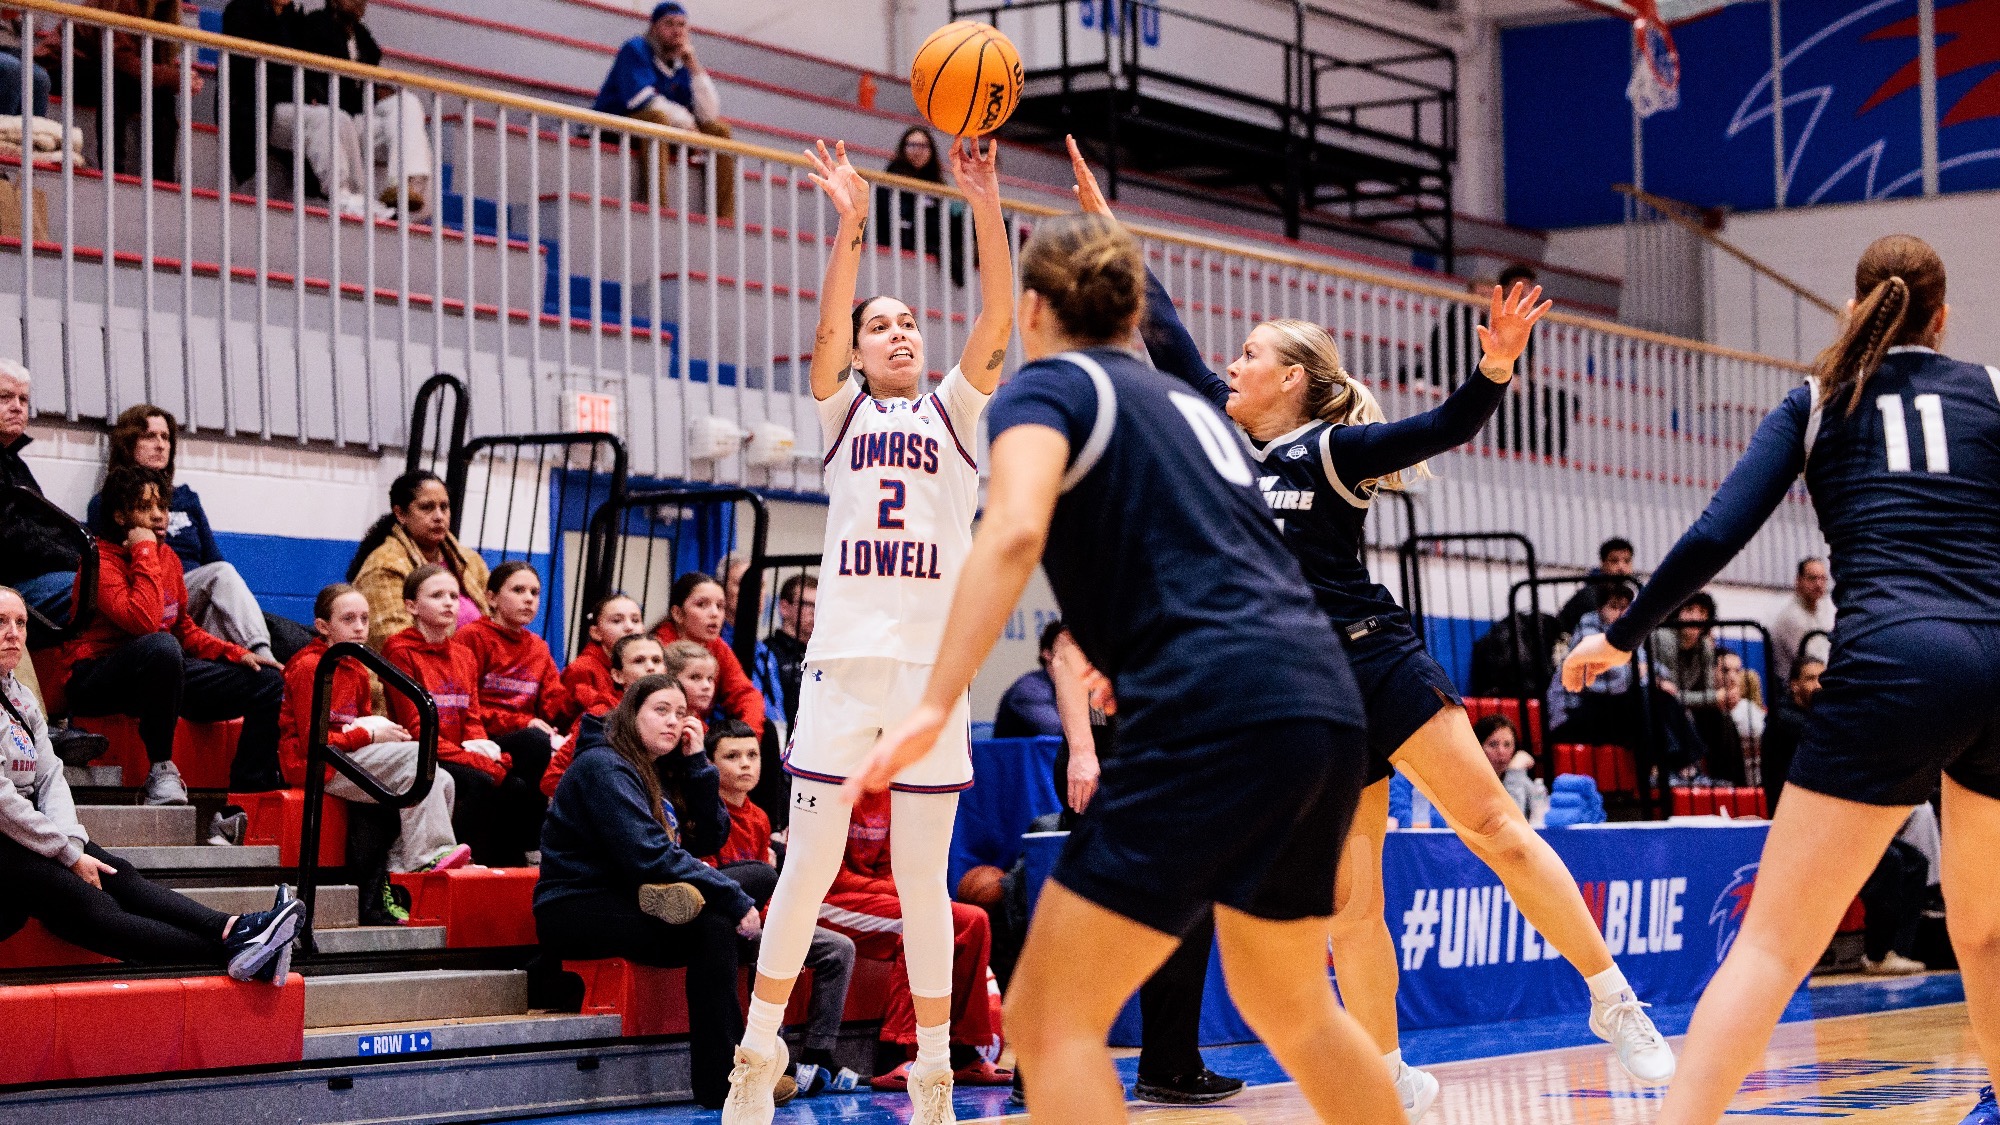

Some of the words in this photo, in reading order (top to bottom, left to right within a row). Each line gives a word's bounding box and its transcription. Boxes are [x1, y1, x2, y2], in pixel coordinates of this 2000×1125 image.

[850, 431, 939, 475] UMASS
[1167, 390, 1253, 487] 0
[1875, 393, 1950, 474] 11
[877, 478, 906, 530] 2
[838, 540, 942, 580] LOWELL
[374, 1035, 402, 1054] ROW
[410, 1033, 417, 1051] 1
